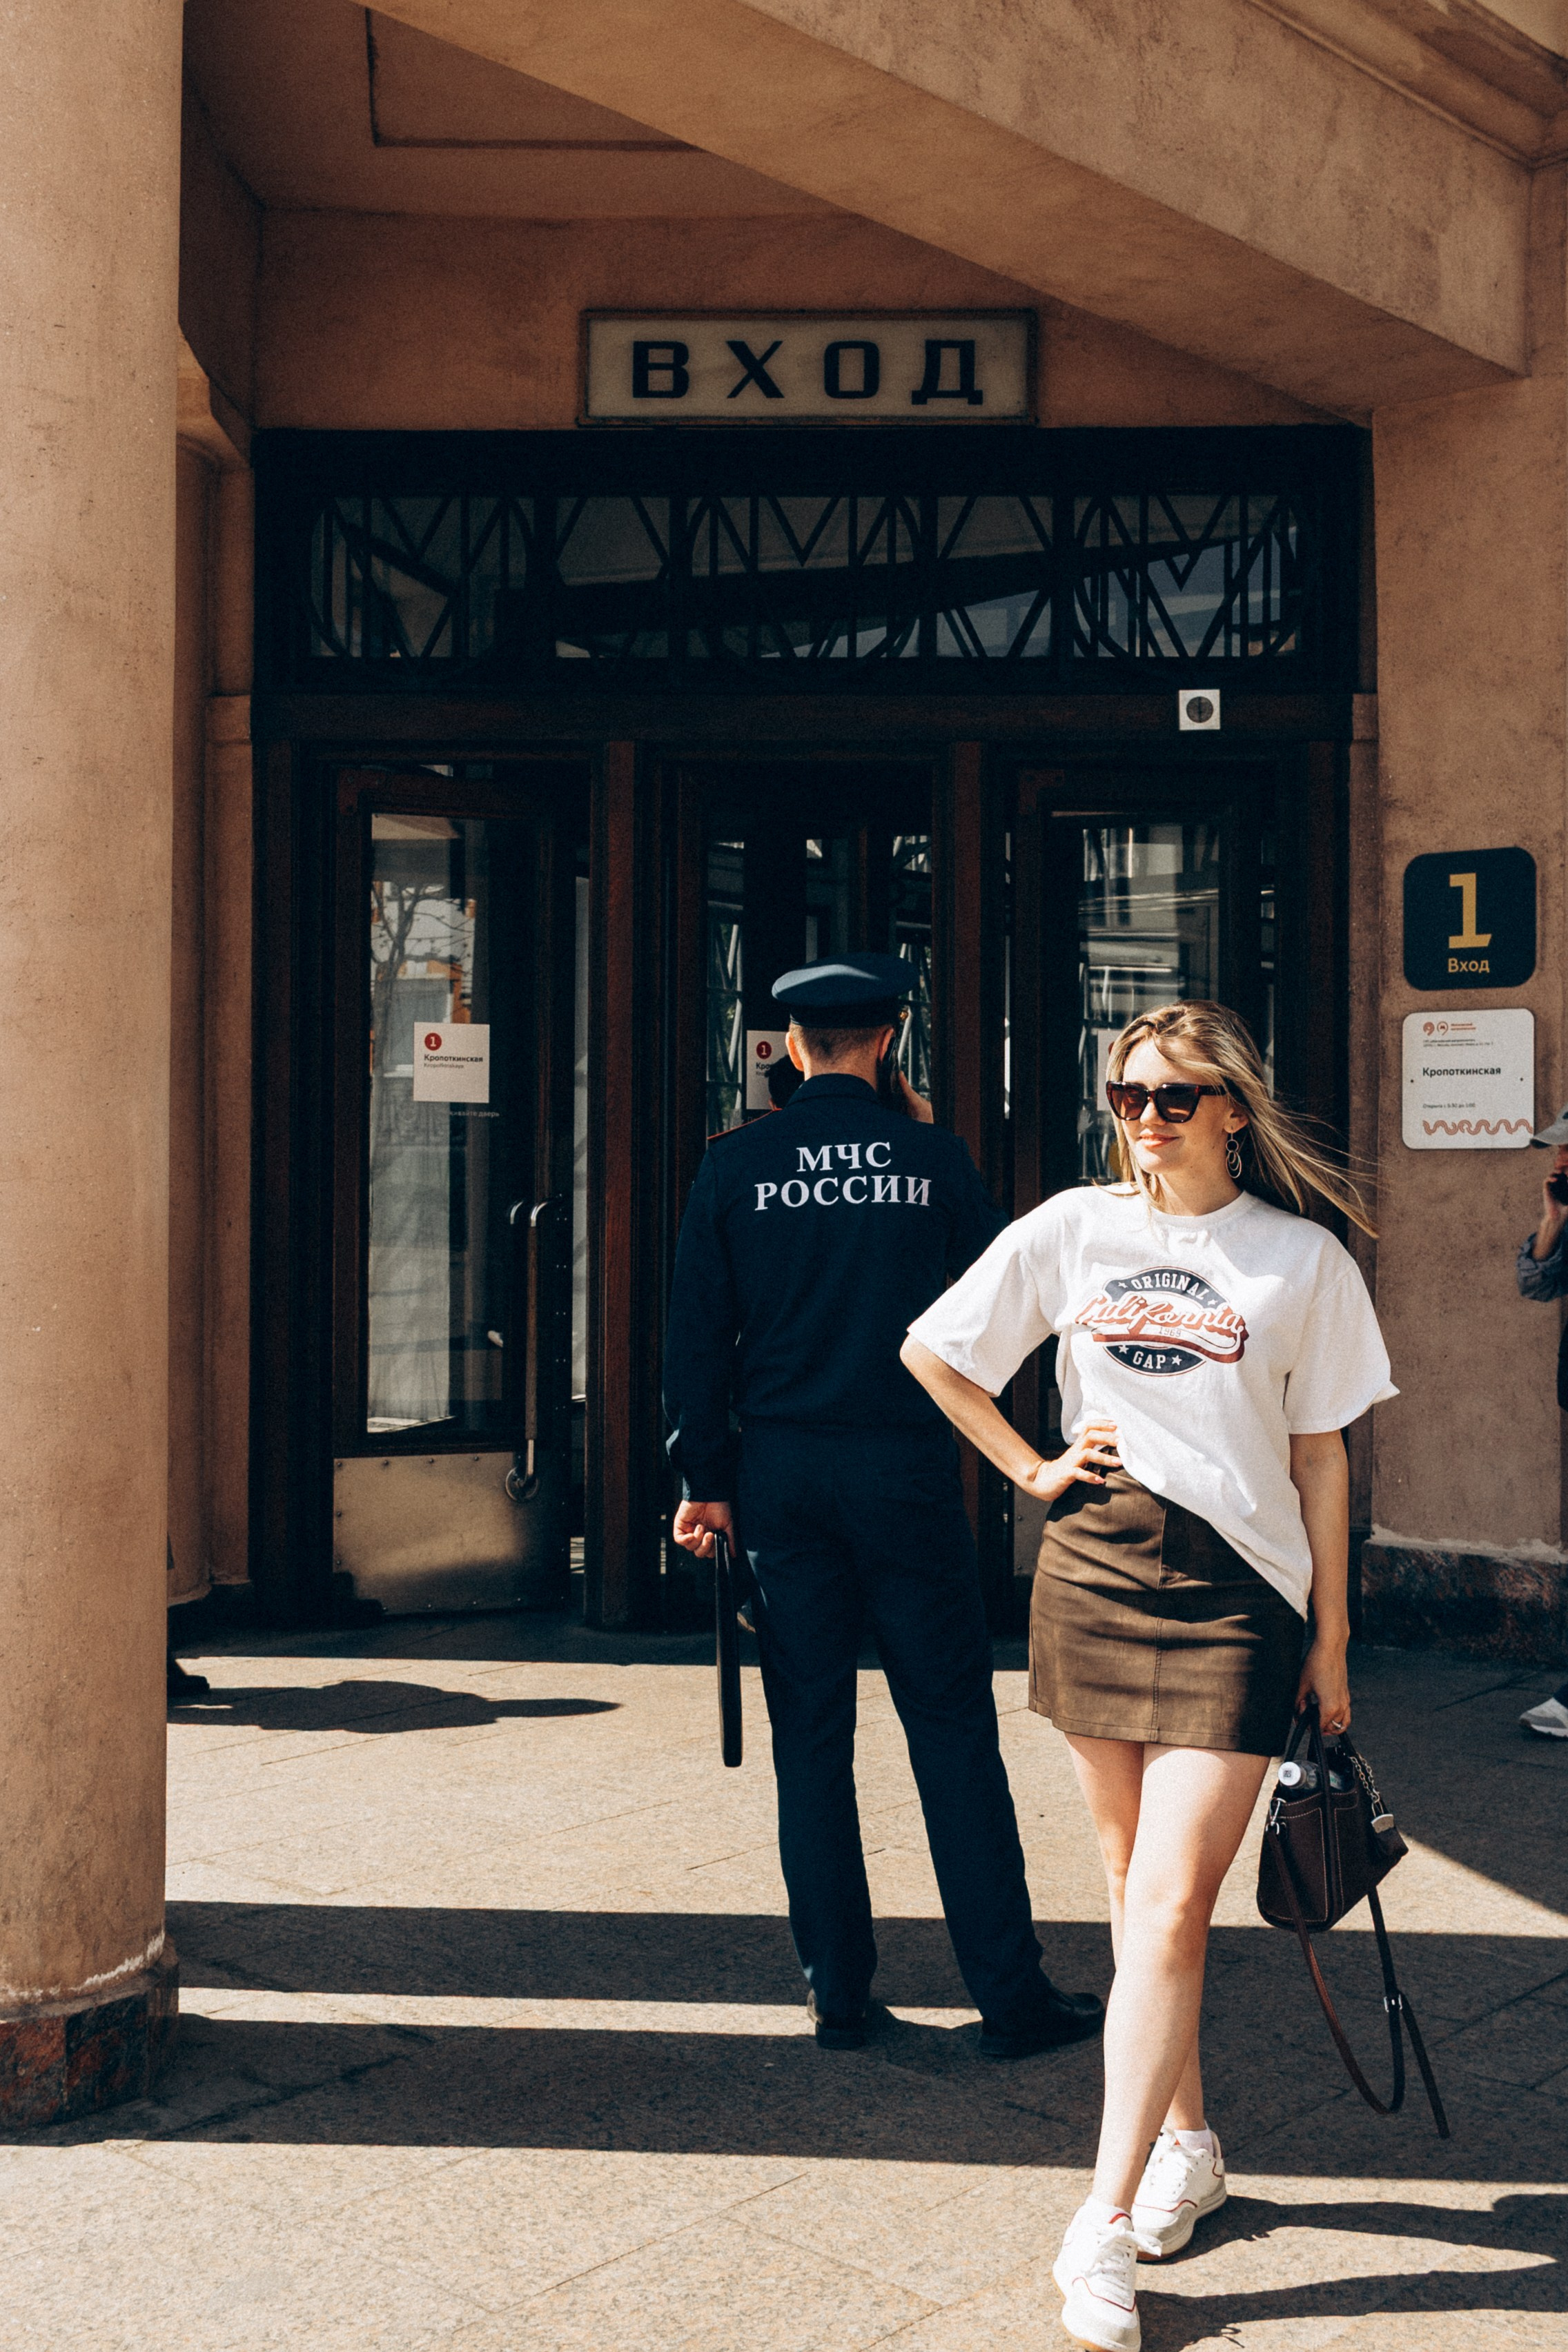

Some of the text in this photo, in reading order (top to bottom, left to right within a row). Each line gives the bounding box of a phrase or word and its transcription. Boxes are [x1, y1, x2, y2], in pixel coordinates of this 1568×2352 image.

[632, 339, 983, 406] ВХОД
[1449, 872, 1492, 949] 1
[1448, 957, 1490, 974] Вход
[430, 1036, 437, 1048] 1
[761, 1045, 767, 1055] 1
[424, 1054, 483, 1063] Кропоткинская
[1422, 1066, 1501, 1077] Кропоткинская
[796, 1142, 892, 1172] МЧС
[754, 1175, 932, 1211] РОССИИ
[1131, 1273, 1209, 1300] ORIGINAL
[1075, 1295, 1248, 1336] California
[1158, 1326, 1182, 1337] 1969
[1133, 1351, 1166, 1369] GAP
